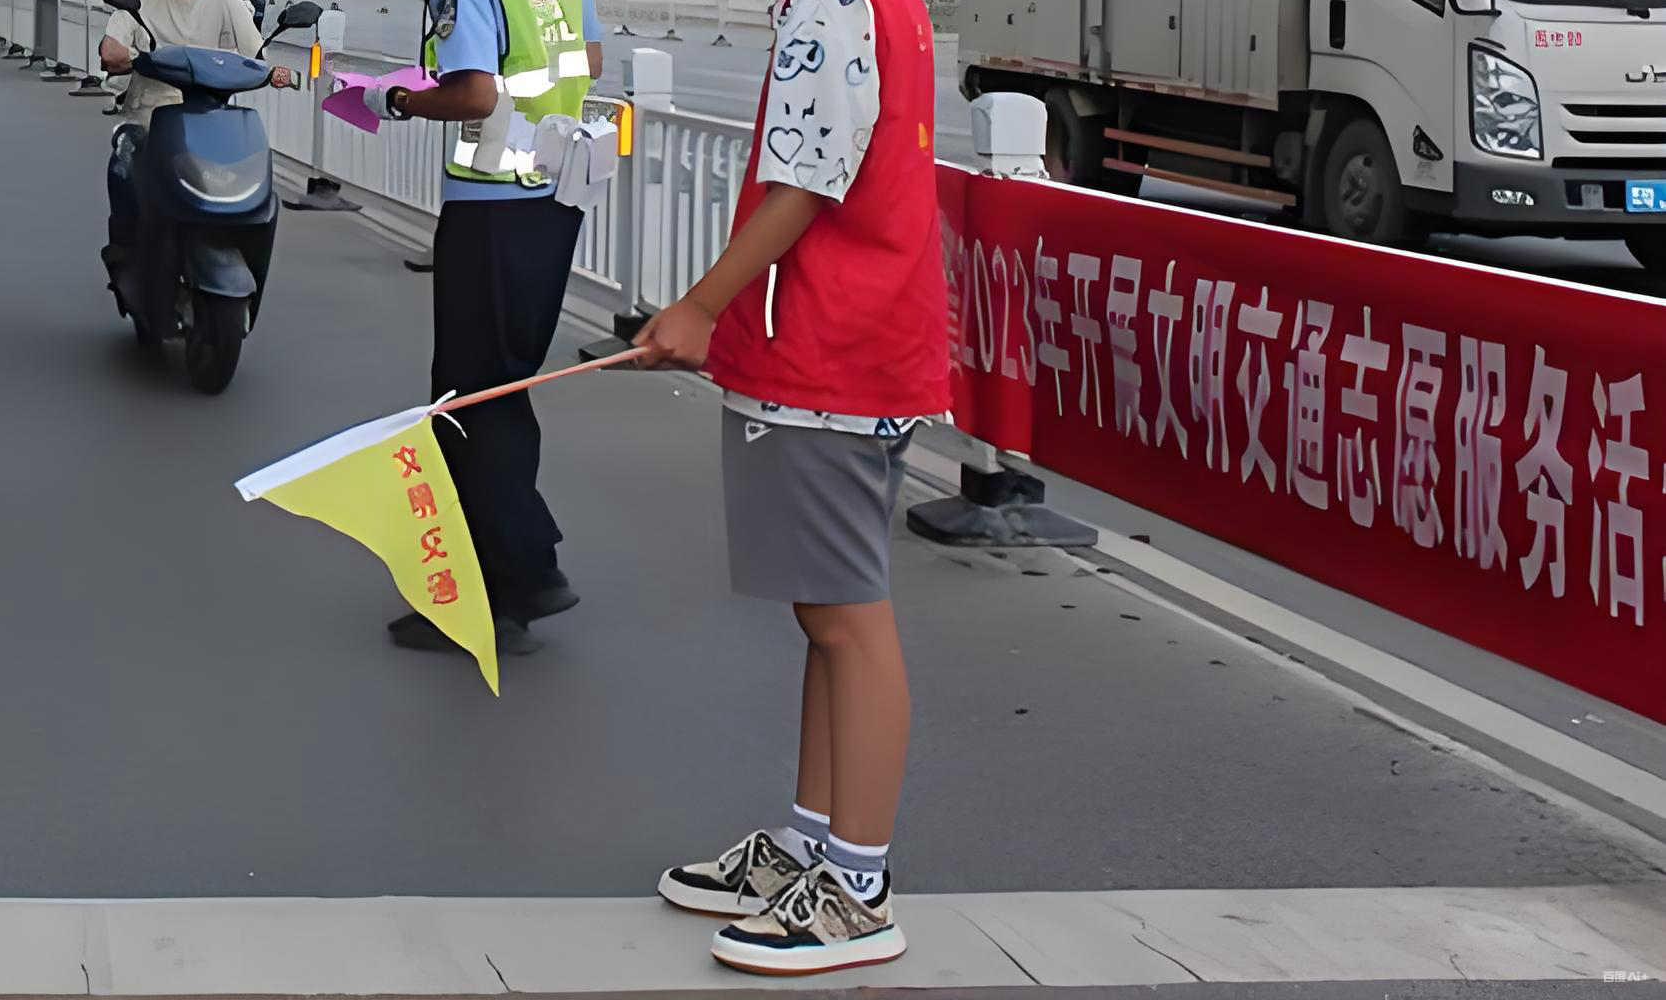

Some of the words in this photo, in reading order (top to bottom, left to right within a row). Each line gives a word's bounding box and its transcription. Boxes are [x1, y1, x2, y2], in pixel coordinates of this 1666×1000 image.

[938, 210, 1666, 627] 2023年开展文明交通志愿服务活
